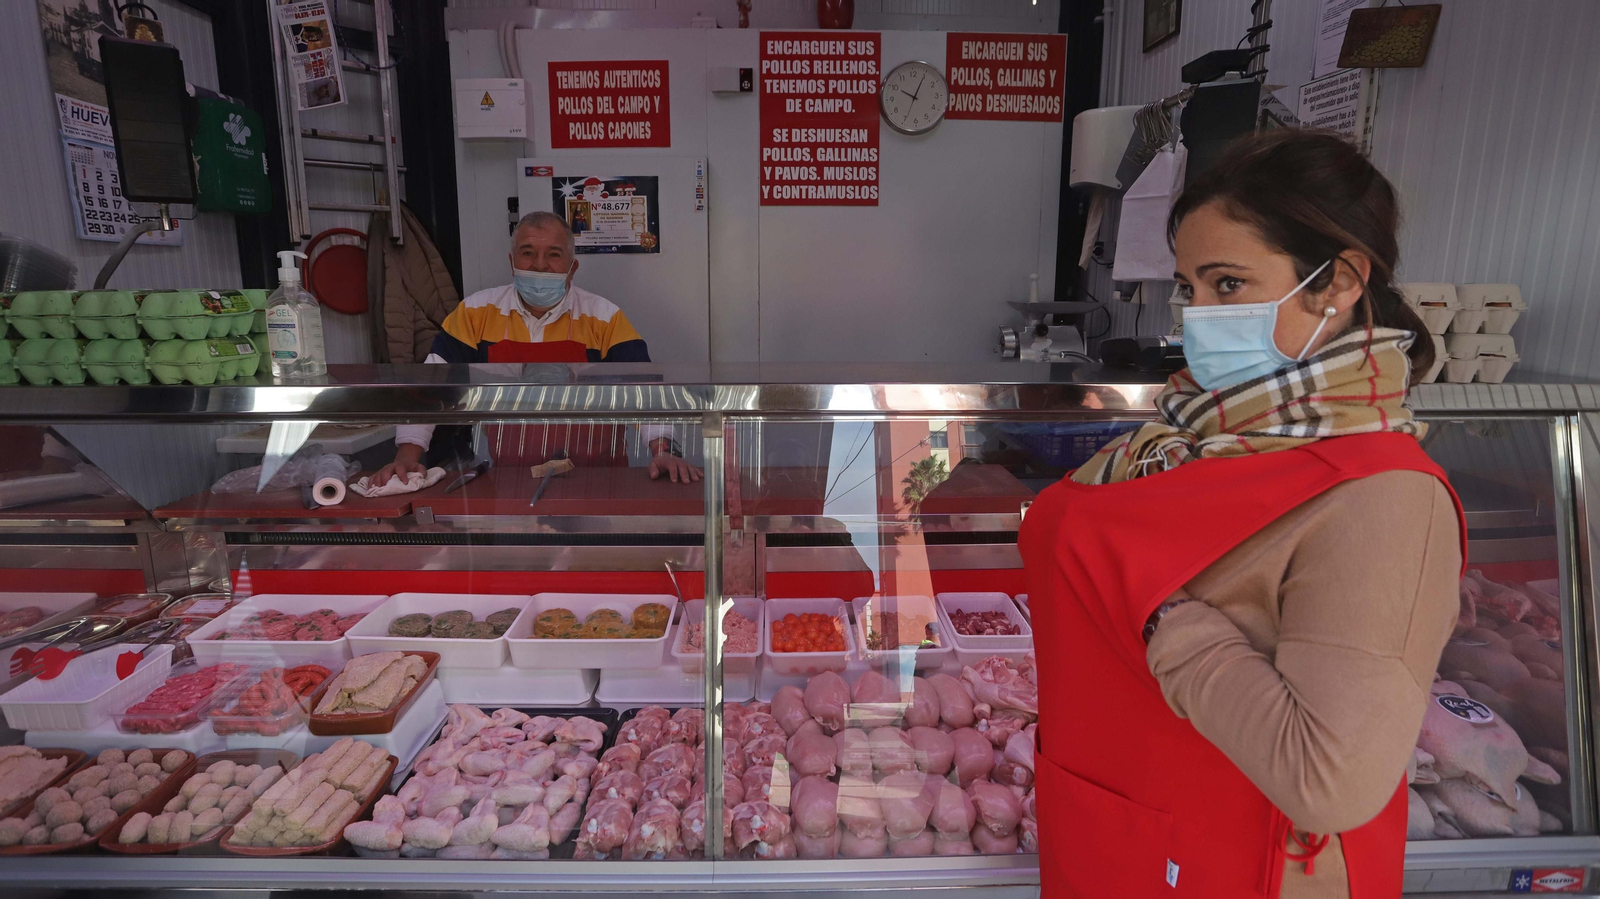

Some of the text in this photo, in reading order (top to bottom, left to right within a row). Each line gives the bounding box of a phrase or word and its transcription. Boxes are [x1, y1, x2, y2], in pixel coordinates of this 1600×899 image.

[767, 40, 874, 55] ENCARGUEN SUS
[962, 41, 1048, 61] ENCARGUEN SUS
[762, 60, 879, 75] POLLOS RELLENOS.
[556, 69, 661, 89] TENEMOS AUTENTICOS
[951, 67, 1056, 90] POLLOS, GALLINAS Y
[1312, 79, 1339, 93] establecimiento
[1340, 76, 1348, 84] tiene
[1349, 72, 1357, 81] libro
[764, 79, 877, 94] TENEMOS POLLOS
[558, 96, 660, 115] POLLOS DEL CAMPO Y
[786, 99, 855, 113] DE CAMPO.
[949, 93, 1060, 114] PAVOS DESHUESADOS
[1316, 98, 1336, 110] consumidor
[1311, 113, 1338, 126] establishment
[1338, 120, 1351, 130] which
[569, 121, 651, 140] POLLOS CAPONES
[773, 128, 868, 143] SE DESHUESAN
[226, 144, 254, 156] Fraternidad
[763, 147, 877, 162] POLLOS, GALLINAS
[83, 168, 118, 184] 1 2 3
[764, 166, 876, 180] Y PAVOS. MUSLOS
[83, 182, 121, 197] 8 9 10
[762, 185, 878, 199] Y CONTRAMUSLOS
[84, 196, 94, 206] 15
[98, 198, 108, 208] 16
[113, 200, 122, 209] 17
[85, 209, 99, 220] 22
[99, 211, 113, 222] 23
[113, 213, 126, 223] 24
[128, 214, 140, 224] 25
[88, 223, 115, 234] 29 30
